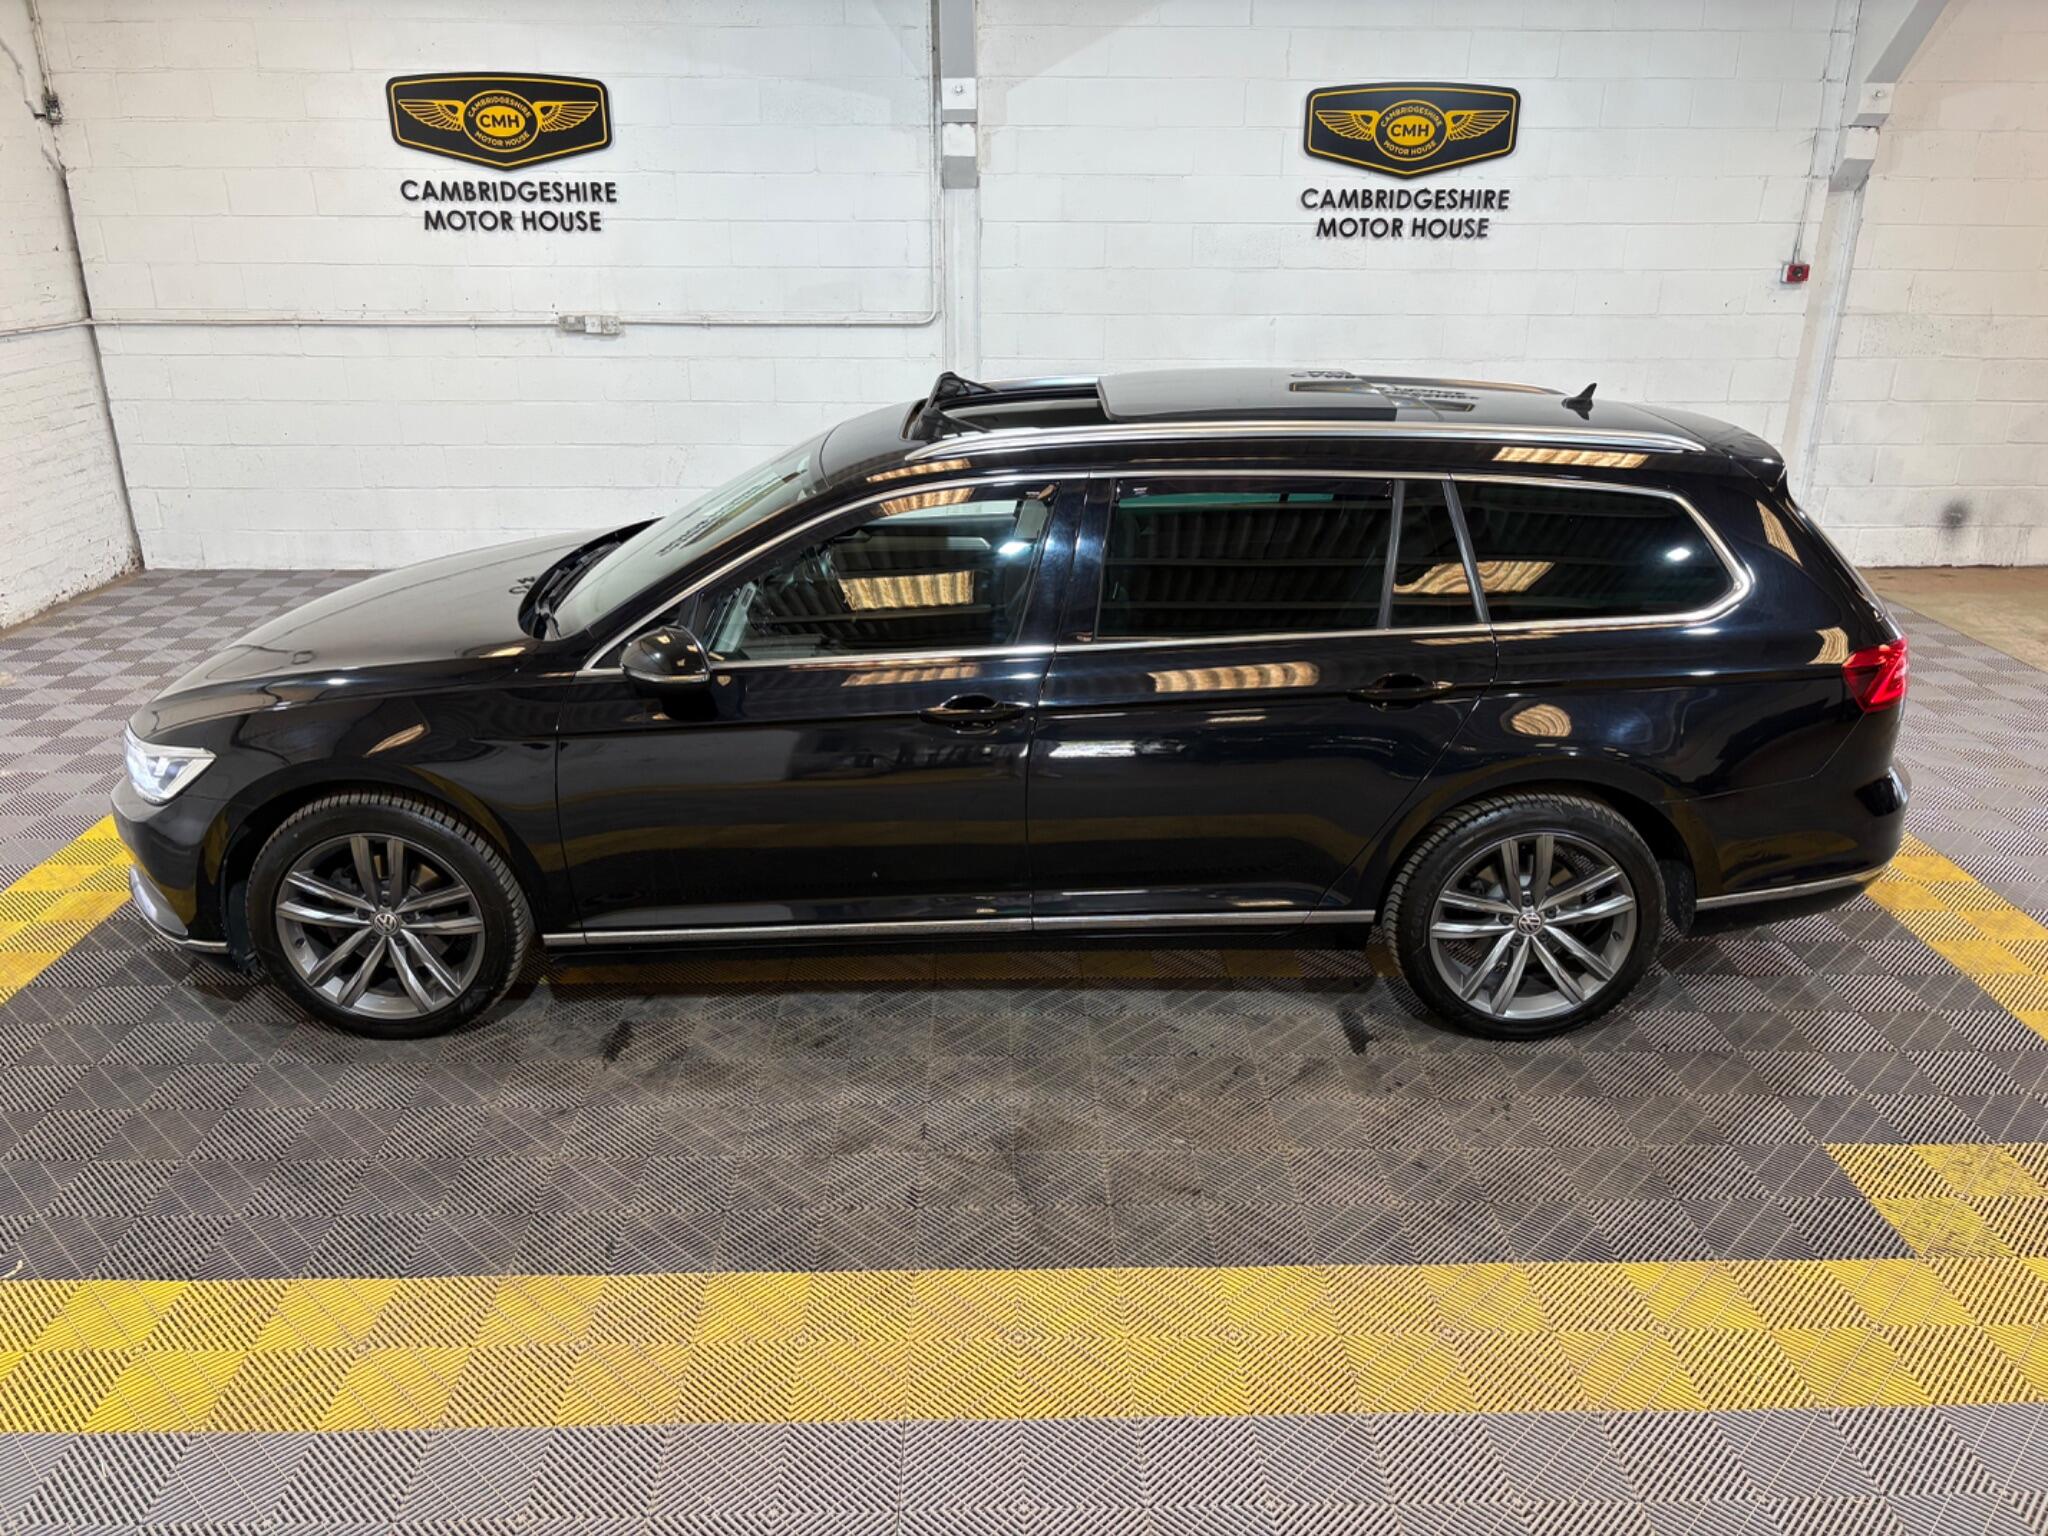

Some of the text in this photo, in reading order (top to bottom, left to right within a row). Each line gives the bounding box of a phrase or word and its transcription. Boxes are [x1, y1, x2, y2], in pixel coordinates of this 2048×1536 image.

[468, 96, 533, 118] CAMBRIDGESHIRE
[1381, 106, 1443, 128] CAMBRIDGESHIRE
[480, 114, 520, 128] CMH
[1391, 124, 1429, 137] CMH
[475, 131, 530, 146] MOTOR HOUSE
[1384, 140, 1436, 155] MOTOR HOUSE
[400, 180, 617, 203] CAMBRIDGESHIRE
[1300, 187, 1511, 210] CAMBRIDGESHIRE
[424, 210, 602, 232] MOTOR HOUSE
[1316, 218, 1490, 239] MOTOR HOUSE
